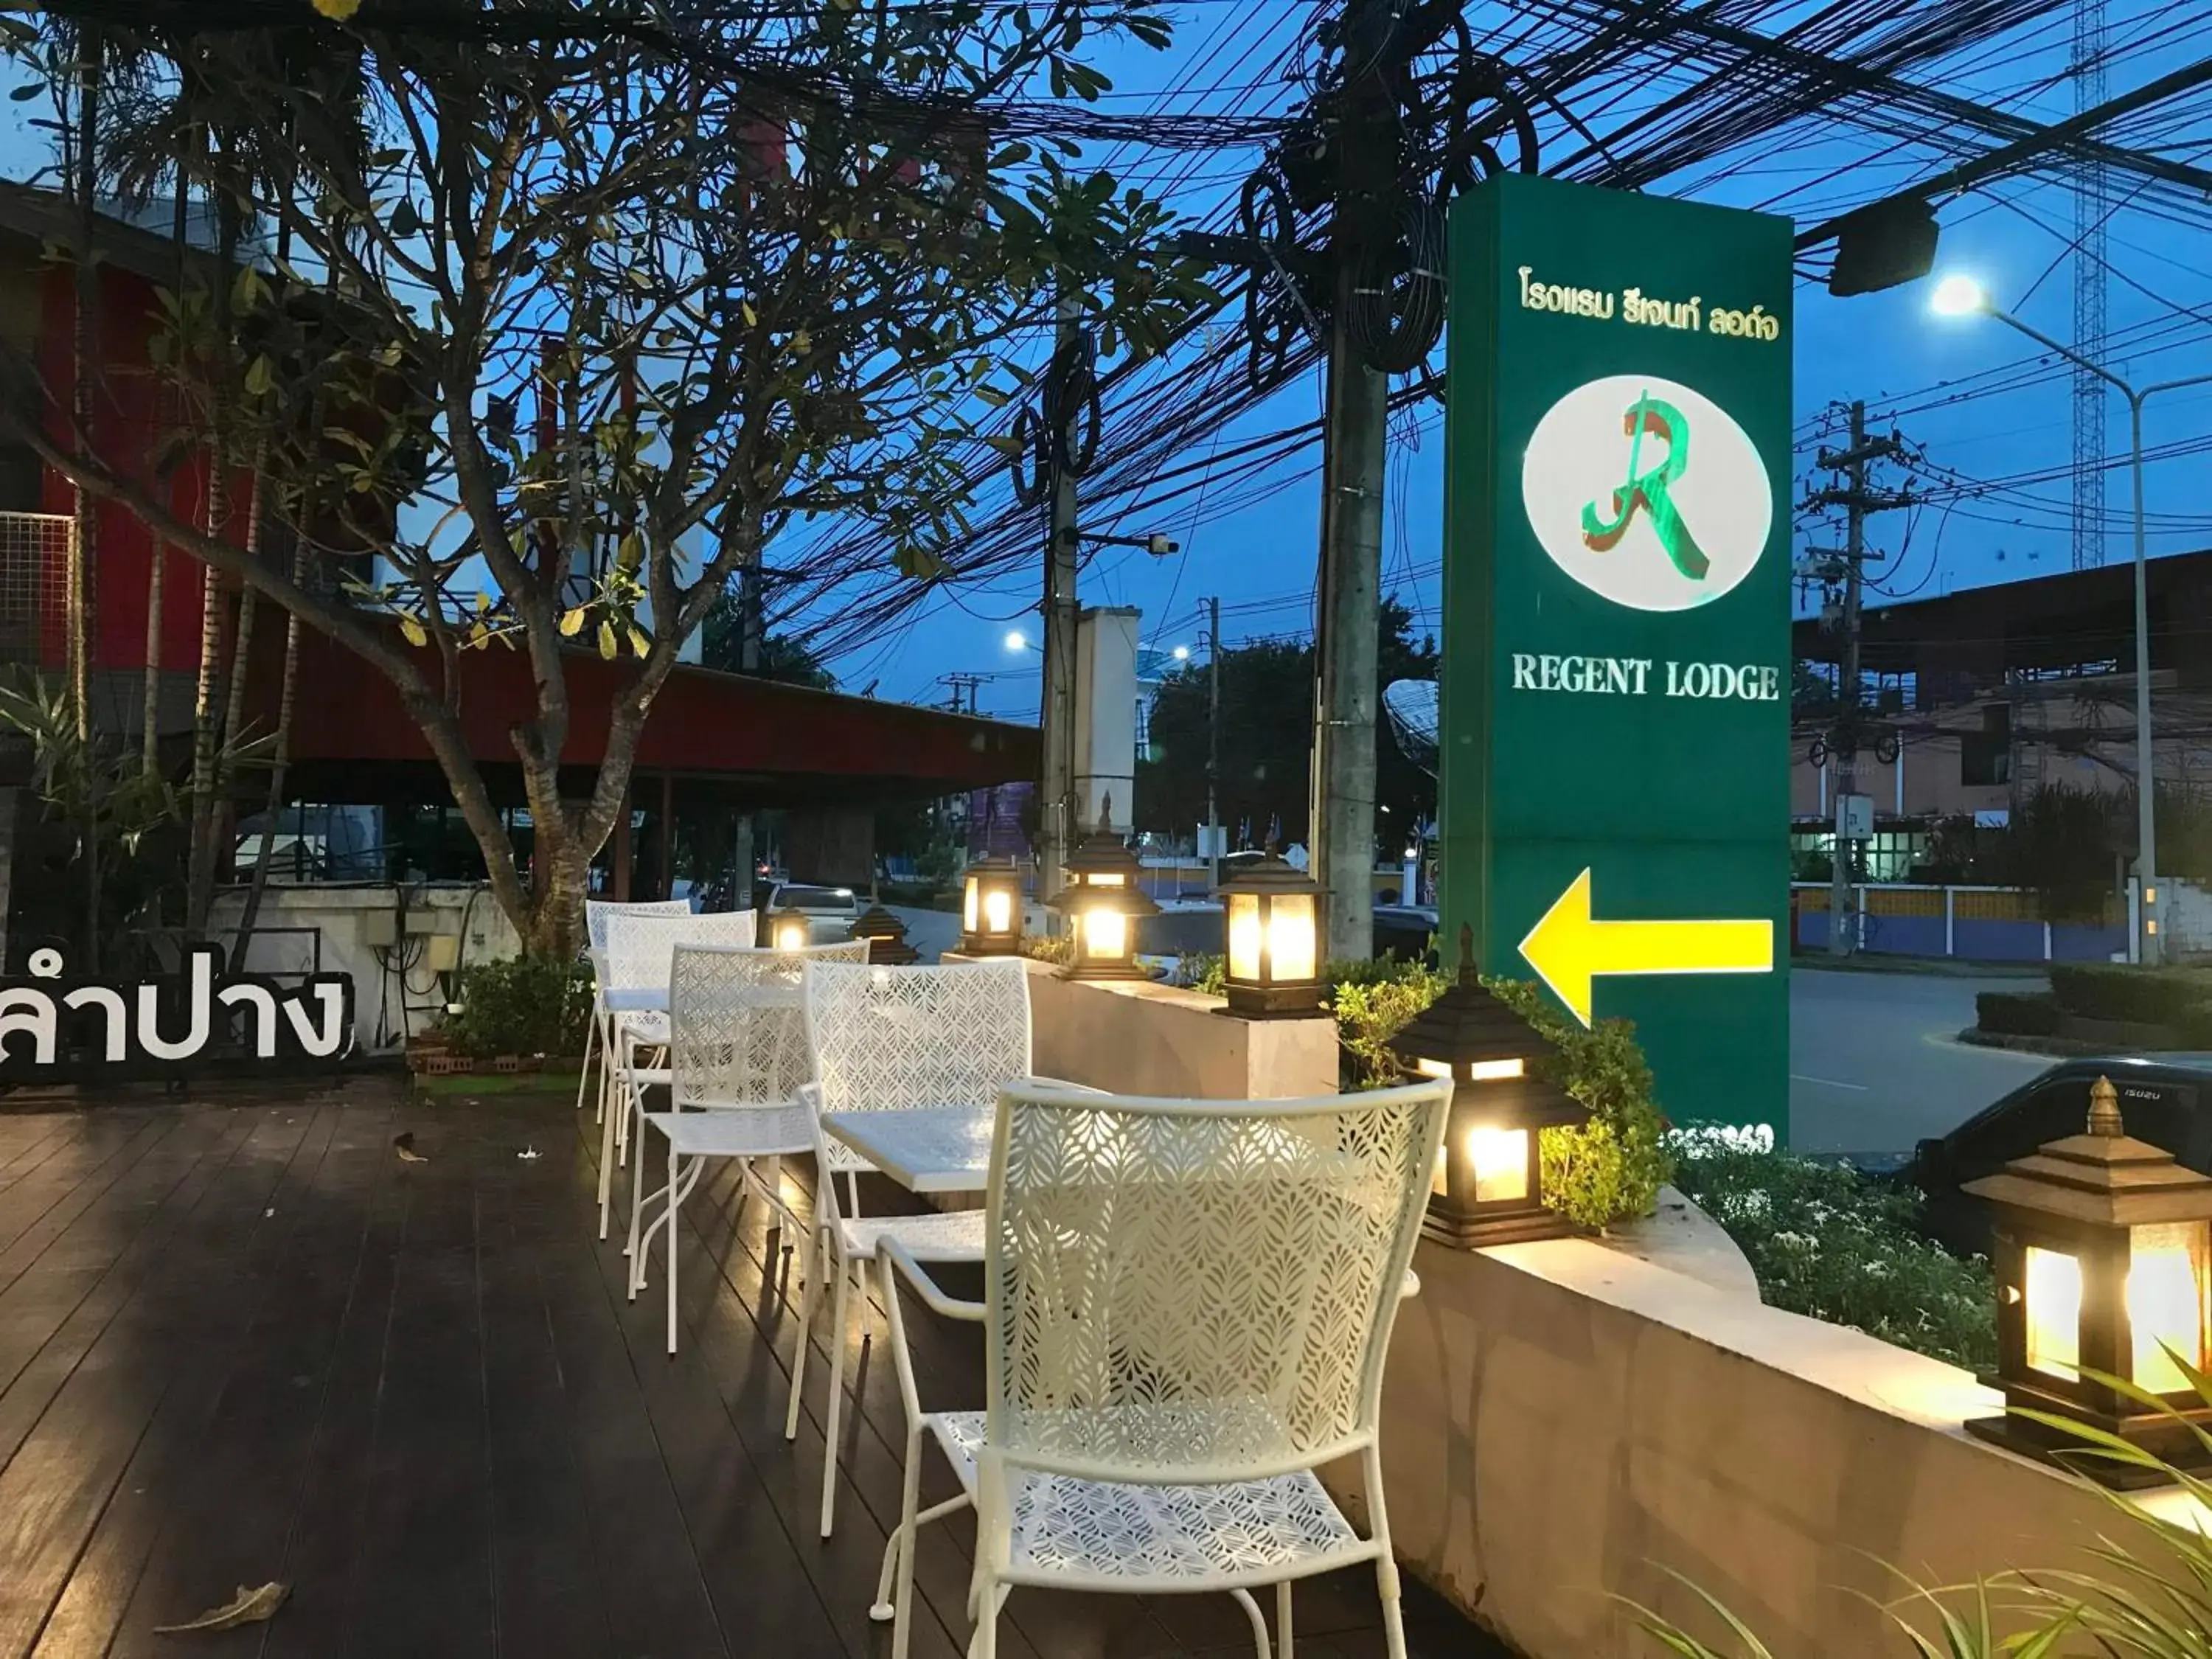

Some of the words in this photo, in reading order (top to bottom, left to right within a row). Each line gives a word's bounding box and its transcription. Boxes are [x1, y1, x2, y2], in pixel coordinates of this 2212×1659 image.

[1518, 265, 1614, 319] โรงแรม
[1512, 653, 1652, 695] REGENT
[1665, 661, 1779, 700] LODGE
[0, 947, 344, 1064] ลำปาง
[2124, 1089, 2160, 1099] ISUZU
